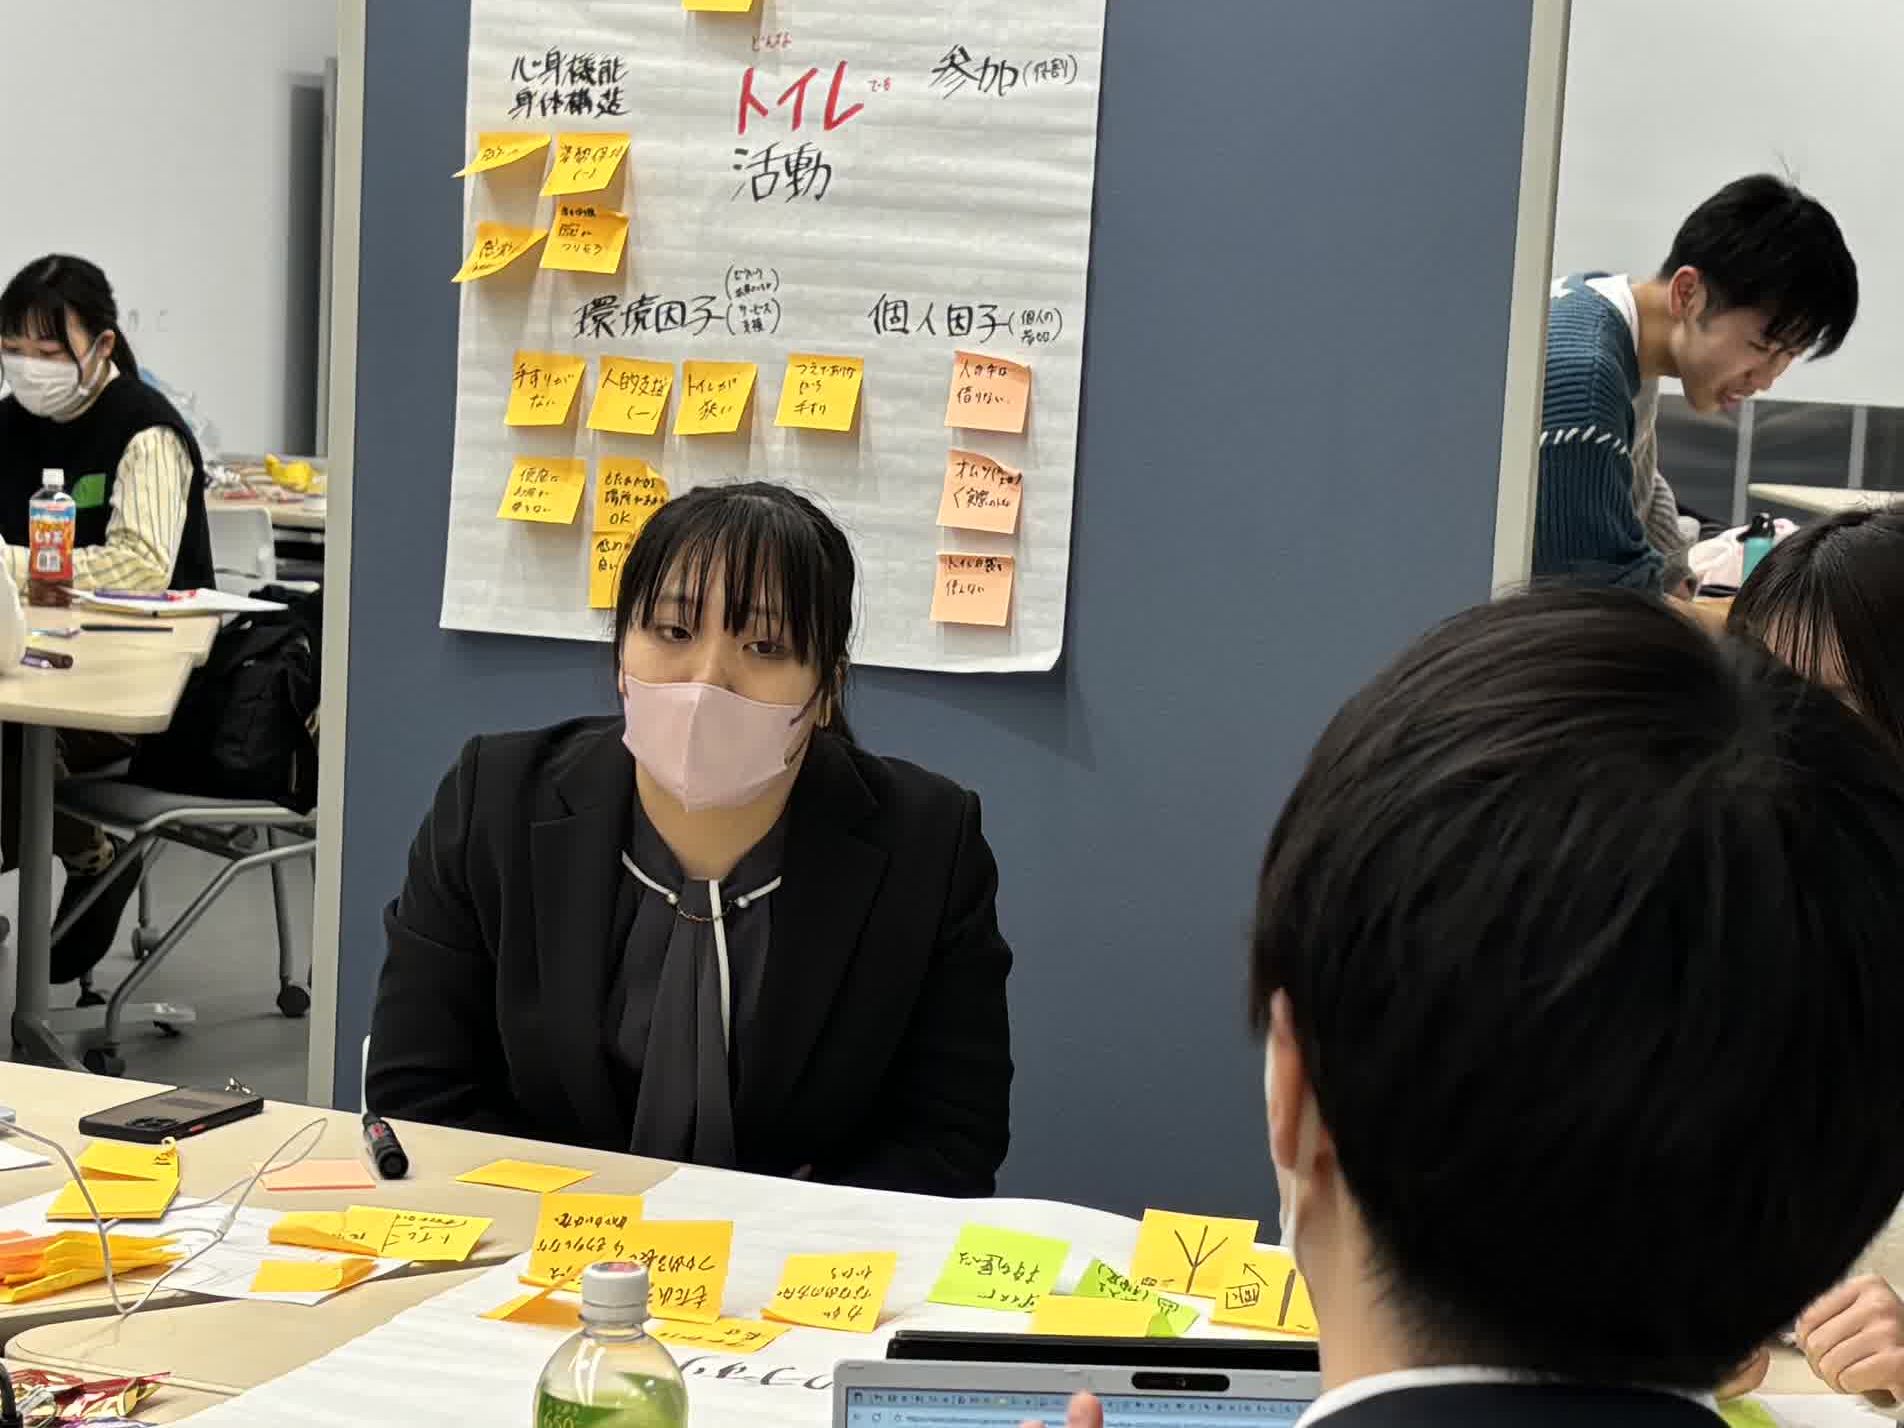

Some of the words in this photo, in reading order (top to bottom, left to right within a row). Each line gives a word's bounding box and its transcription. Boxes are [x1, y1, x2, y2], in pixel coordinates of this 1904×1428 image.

[511, 45, 630, 85] 心身機能
[507, 85, 633, 121] 身体構造
[738, 60, 864, 135] トイレ
[727, 140, 833, 203] 活動
[574, 292, 724, 340] 環境因子
[868, 293, 1002, 344] 個人因子
[512, 362, 575, 388] 手すりが
[688, 373, 738, 397] トイレが
[528, 394, 556, 409] ない
[794, 399, 827, 416] 手すり
[609, 511, 631, 524] OK
